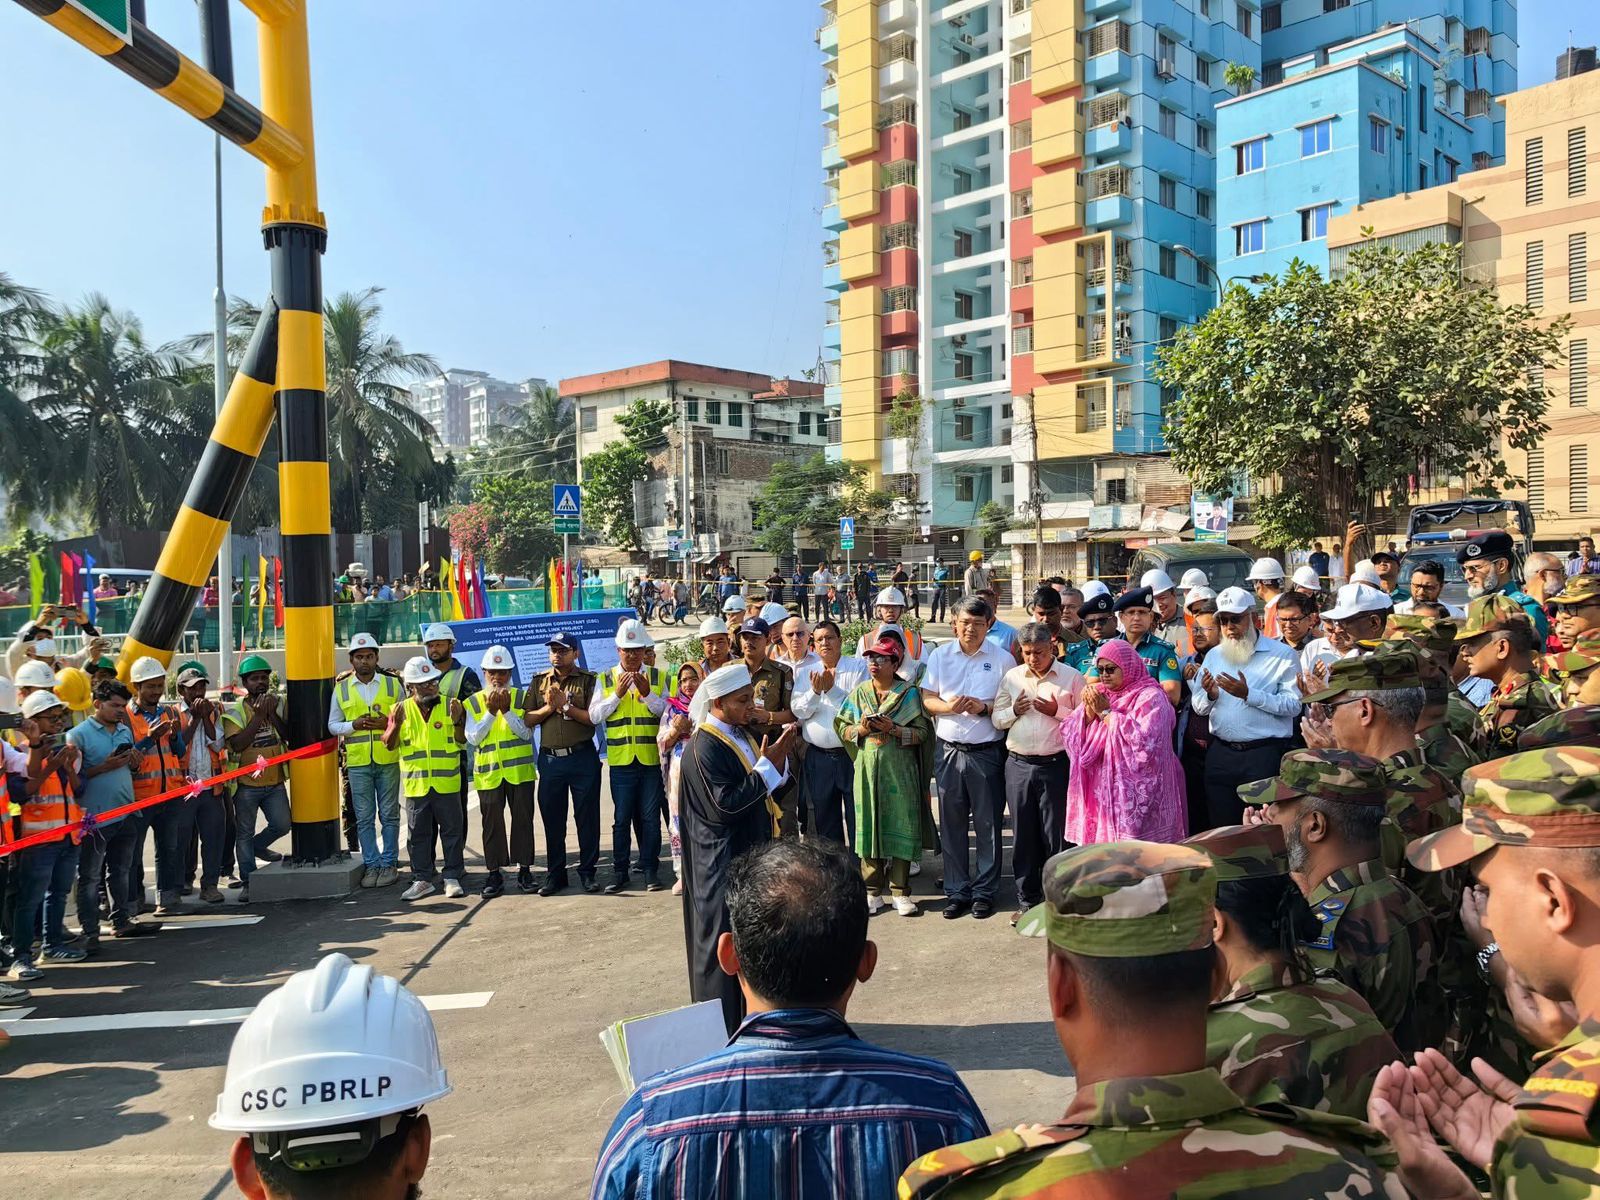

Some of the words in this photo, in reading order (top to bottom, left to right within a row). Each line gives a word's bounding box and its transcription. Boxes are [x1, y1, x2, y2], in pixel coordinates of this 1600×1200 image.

[474, 625, 517, 633] CONSTRUCTION
[518, 622, 552, 630] SUPERVISION
[553, 619, 585, 627] CONSULTANT
[462, 639, 493, 647] PROGRESS
[241, 1086, 287, 1112] CSC
[302, 1076, 392, 1105] PBRLP
